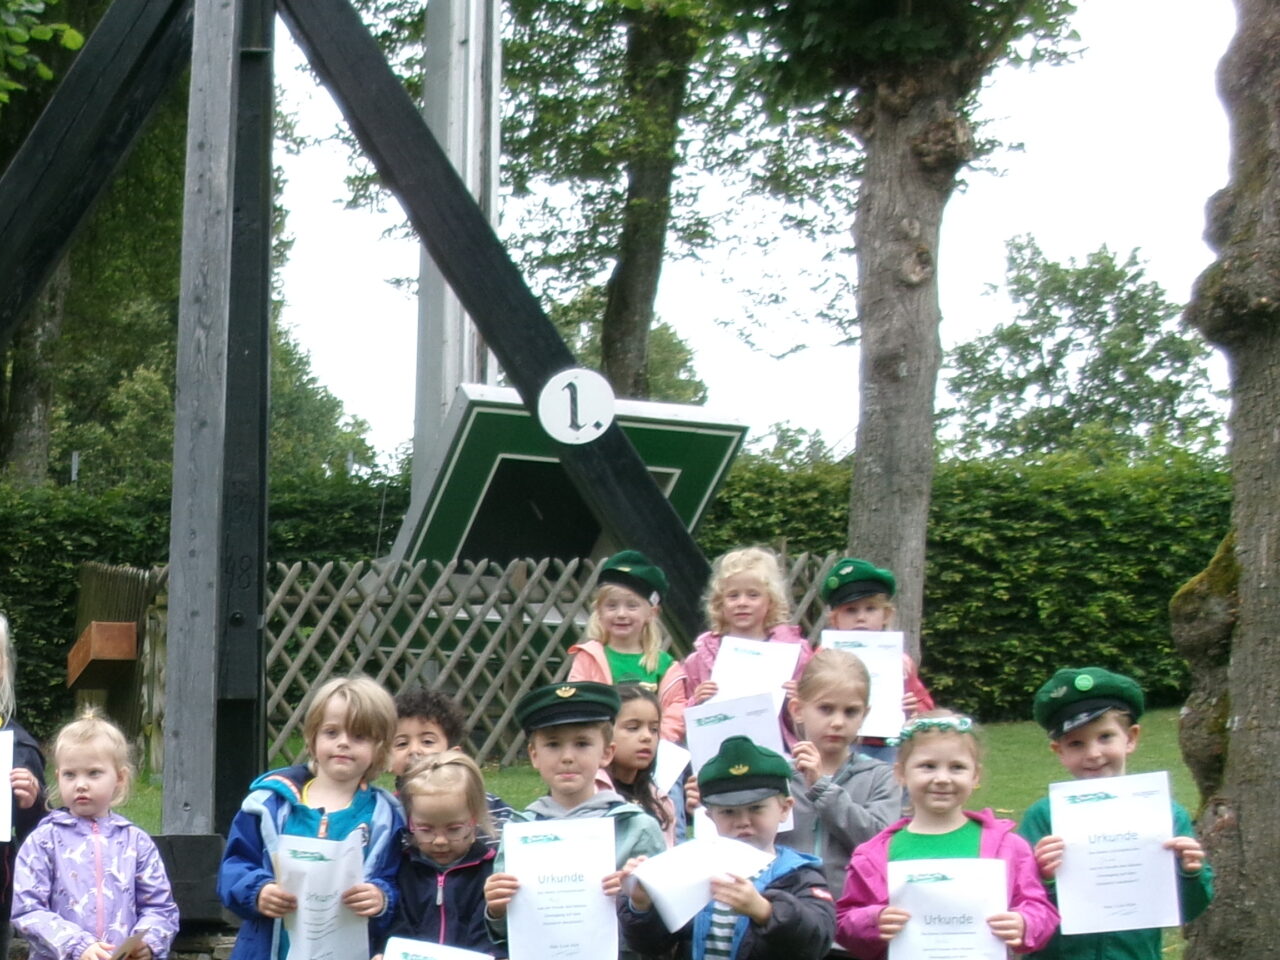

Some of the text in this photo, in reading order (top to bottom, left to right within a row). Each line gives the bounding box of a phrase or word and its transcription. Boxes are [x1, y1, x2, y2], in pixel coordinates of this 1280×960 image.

[561, 381, 604, 432] 1.
[1088, 831, 1139, 844] Urkunde
[537, 872, 585, 884] Urkunde
[924, 914, 973, 925] Urkunde
